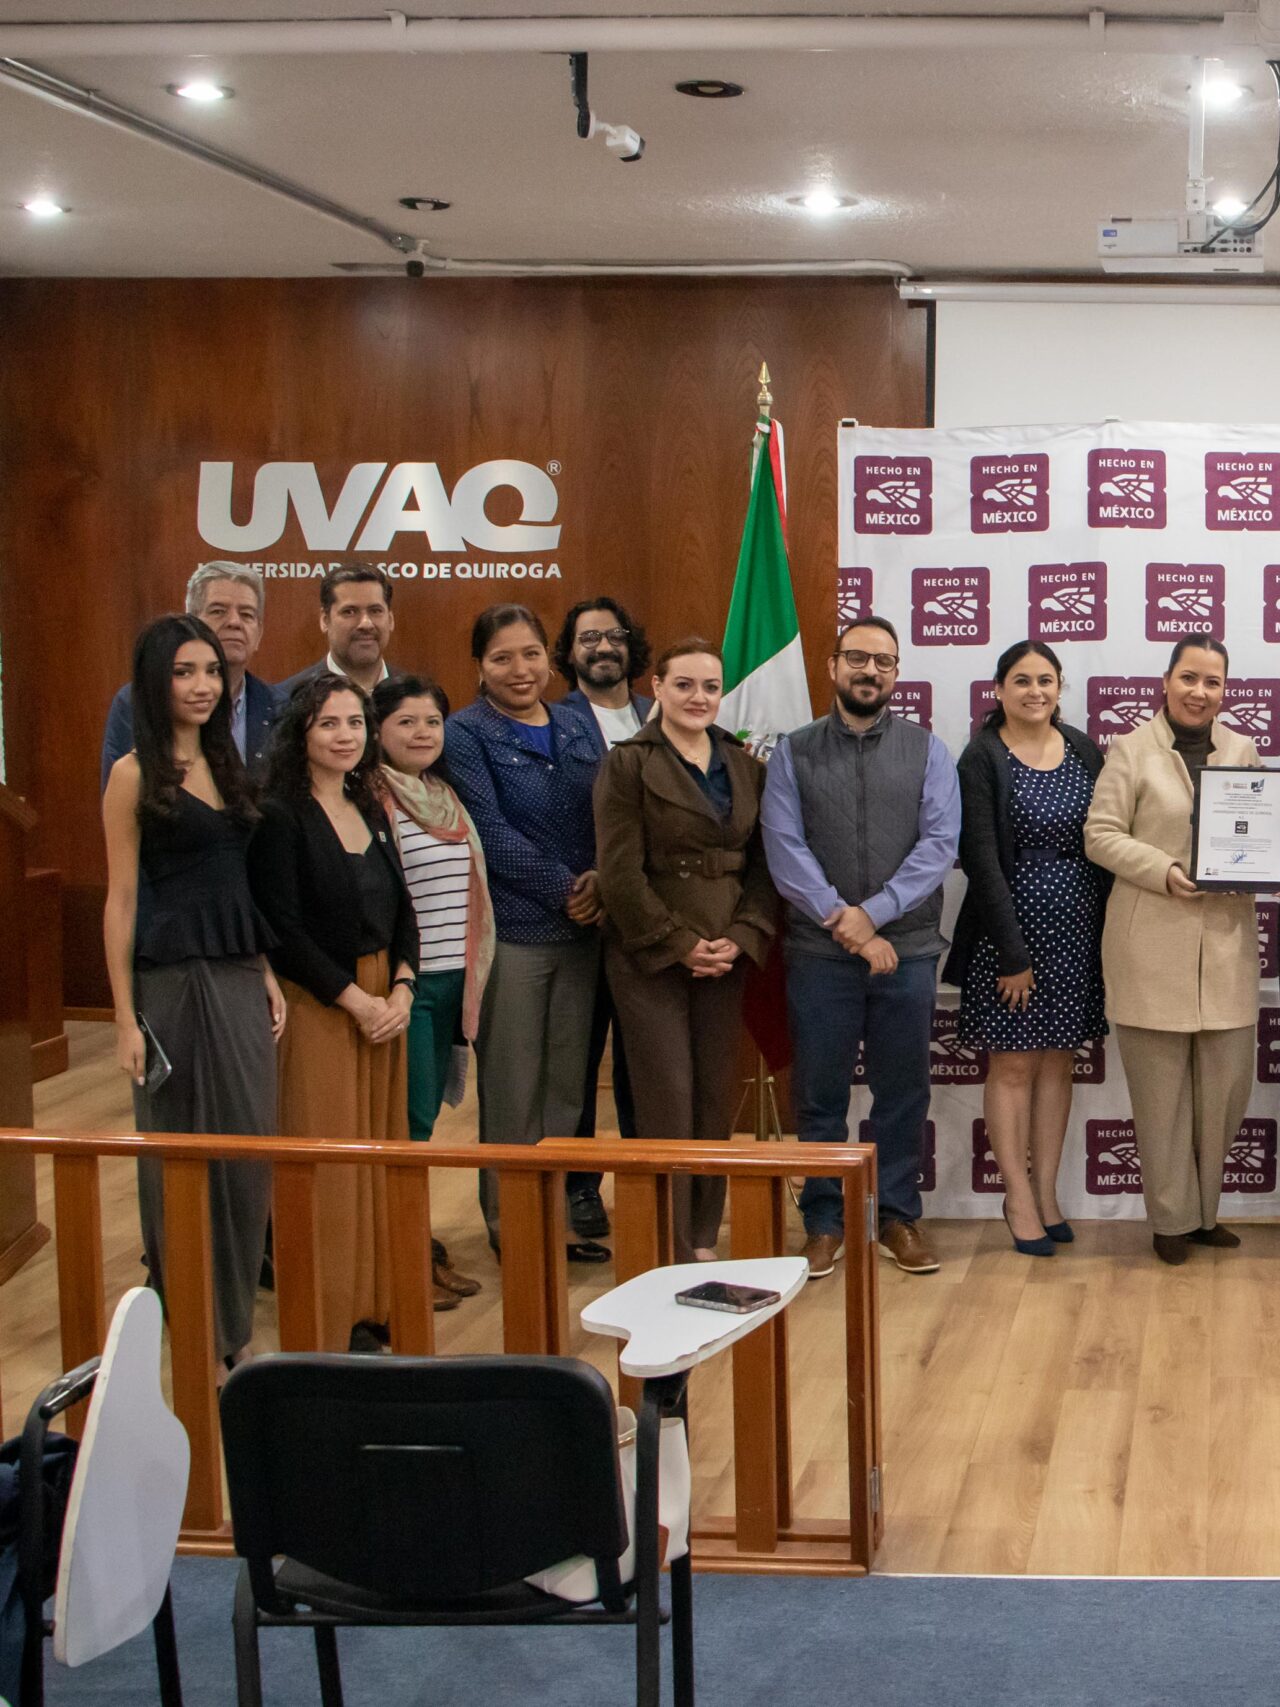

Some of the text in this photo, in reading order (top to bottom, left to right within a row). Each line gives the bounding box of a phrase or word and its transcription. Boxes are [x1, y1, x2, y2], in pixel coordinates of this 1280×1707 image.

[982, 463, 1038, 474] HECHO EN
[1098, 458, 1155, 469] HECHO EN
[1216, 462, 1273, 472] HECHO EN
[865, 466, 921, 476] HECHO EN
[982, 510, 1038, 524] MÉXICO
[1099, 504, 1155, 520] MÉXICO
[1217, 506, 1273, 522] MÉXICO
[865, 510, 921, 526] MÉXICO
[423, 562, 452, 579] DE
[454, 562, 562, 579] QUIROGA
[847, 577, 861, 586] EN
[923, 577, 979, 587] HECHO EN
[1040, 572, 1096, 583] HECHO EN
[1157, 573, 1214, 583] HECHO EN
[922, 622, 978, 637] MÉXICO
[1039, 619, 1095, 633] MÉXICO
[1157, 618, 1213, 633] MÉXICO
[906, 691, 921, 700] EN
[1099, 686, 1155, 697] HECHO EN
[1223, 688, 1272, 697] ECHO EN
[1097, 1129, 1134, 1138] HECHO
[1252, 1128, 1266, 1137] EN
[1097, 1172, 1142, 1186] MÉXIC
[1223, 1171, 1265, 1185] ÉXICO
